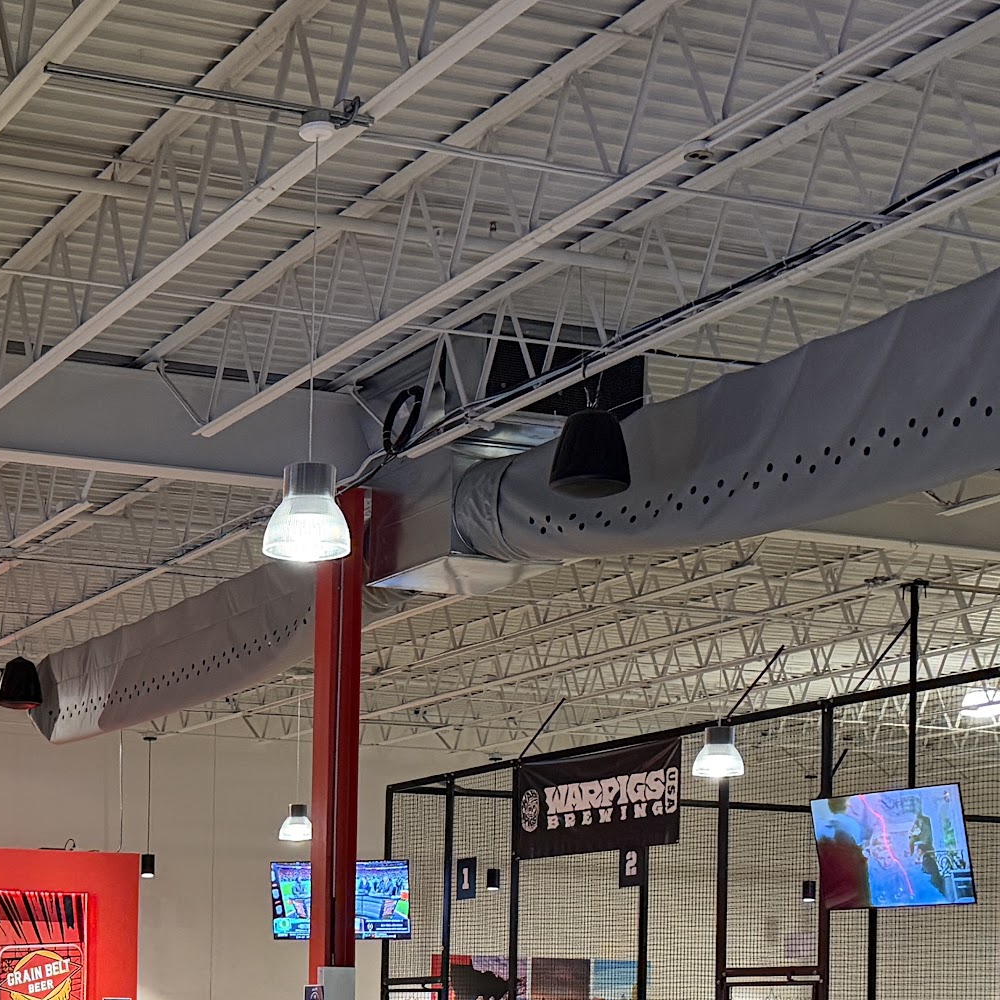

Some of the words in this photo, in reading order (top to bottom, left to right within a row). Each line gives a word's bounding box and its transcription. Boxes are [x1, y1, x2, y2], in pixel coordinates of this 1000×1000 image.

[544, 768, 666, 815] WARPIGS
[547, 801, 664, 830] BREWING
[625, 850, 638, 877] 2
[461, 867, 470, 890] 1
[7, 966, 43, 987] GRAIN
[45, 958, 70, 978] BELT
[28, 979, 55, 994] BEER
